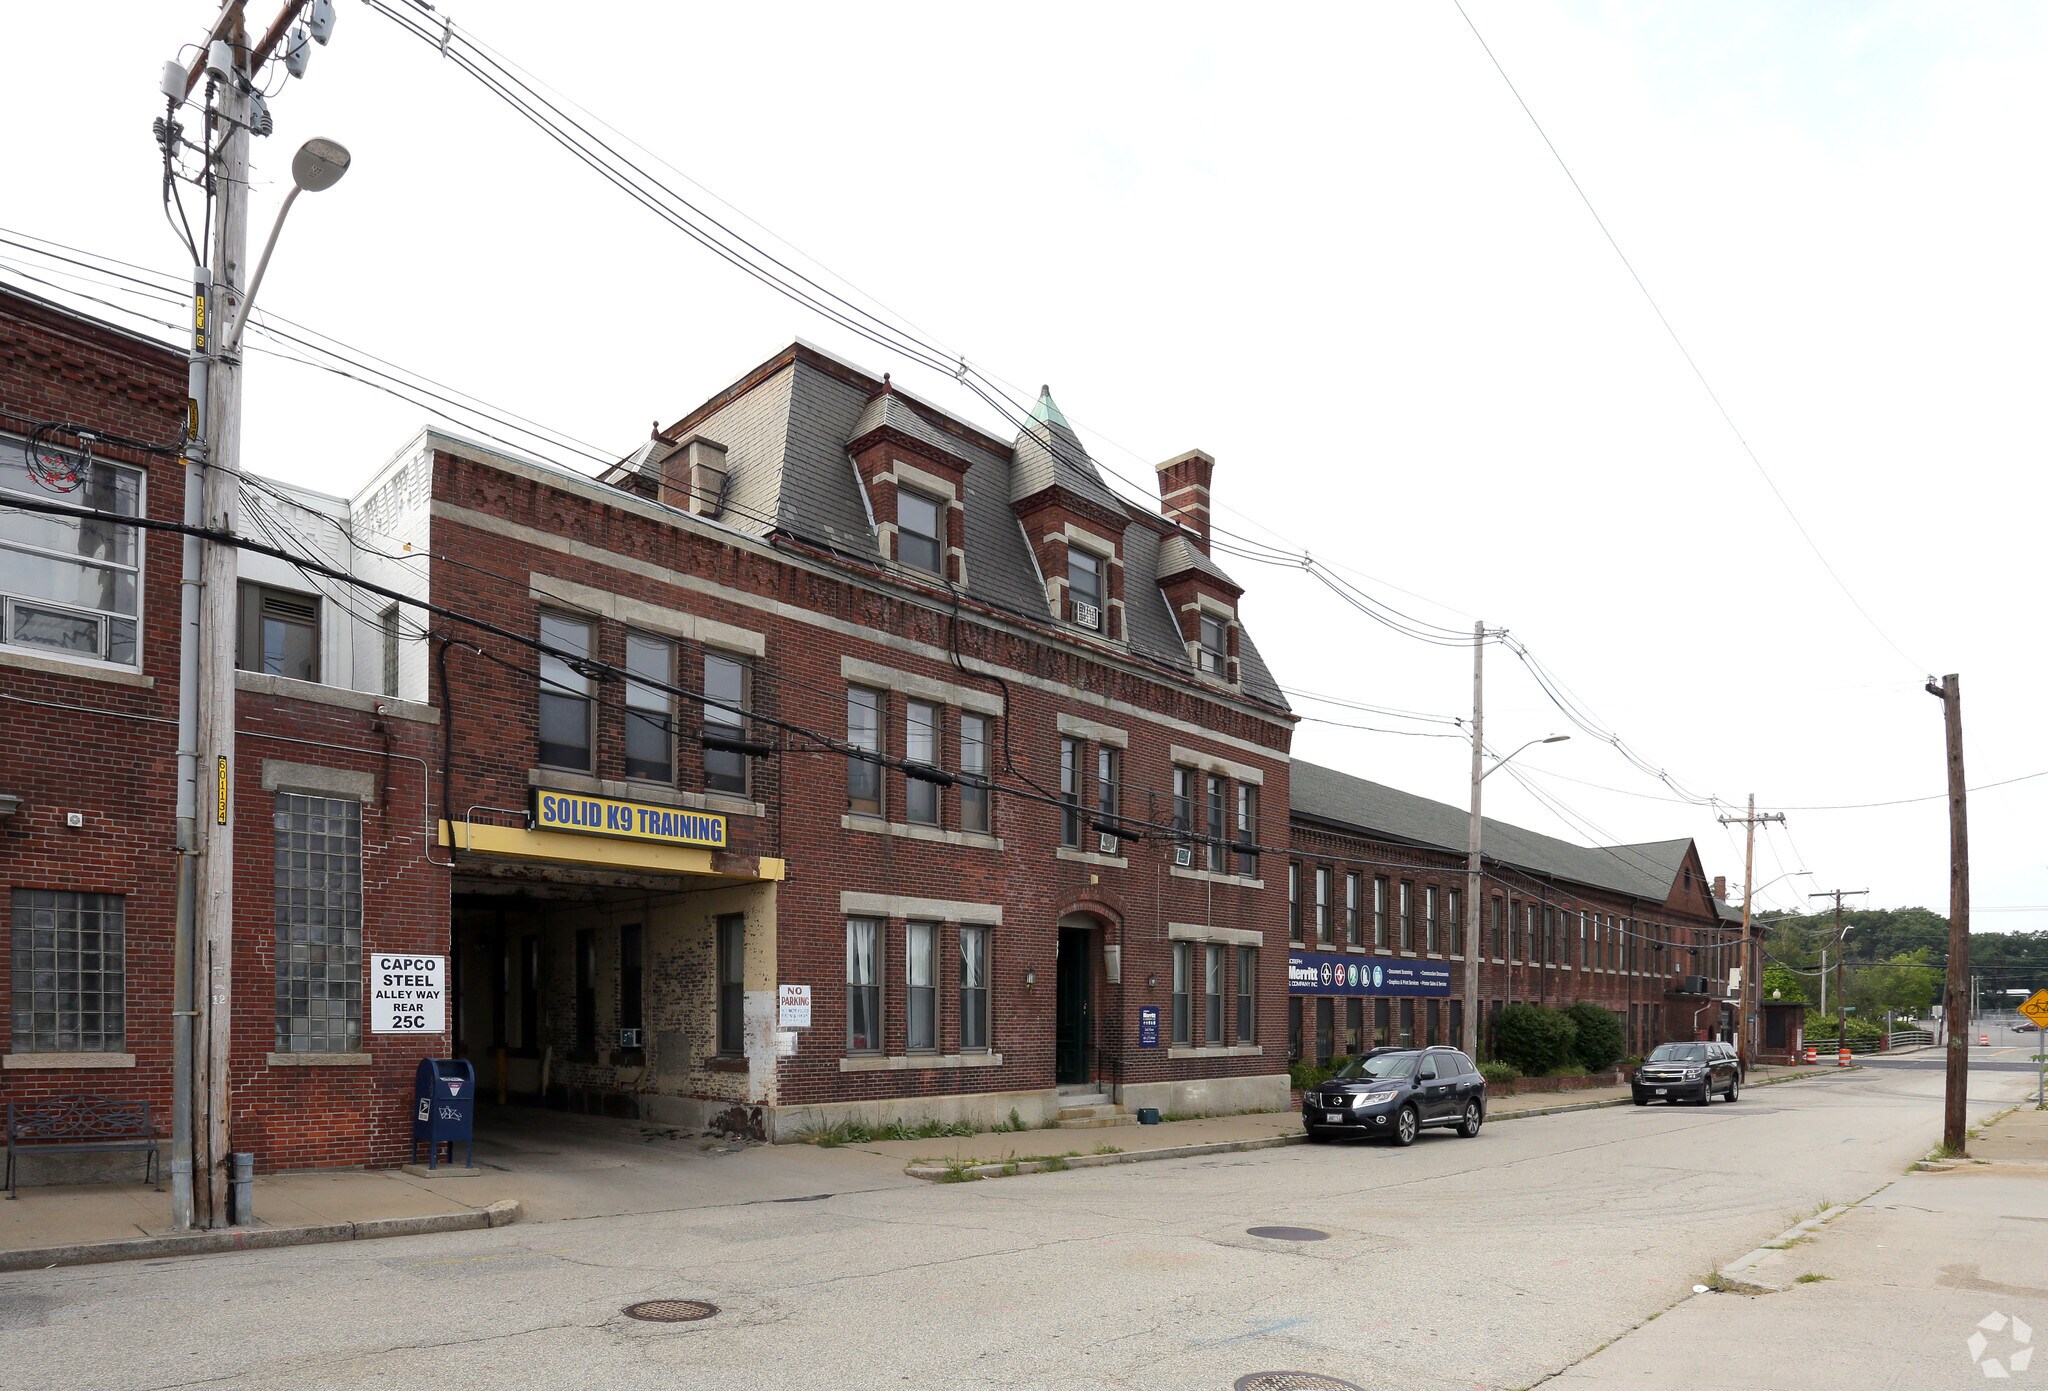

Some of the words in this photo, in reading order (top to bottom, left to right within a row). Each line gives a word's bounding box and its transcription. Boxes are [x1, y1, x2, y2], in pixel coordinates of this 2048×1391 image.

[543, 795, 601, 827] SOLID
[607, 805, 633, 832] K9
[637, 808, 722, 843] TRAINING
[380, 958, 436, 971] CAPCO
[383, 974, 434, 987] STEEL
[375, 990, 413, 999] ALLEY
[416, 990, 440, 999] WAY
[787, 987, 802, 995] NO
[781, 996, 810, 1006] PARKING
[393, 1003, 424, 1012] REAR
[392, 1015, 425, 1029] 25C
